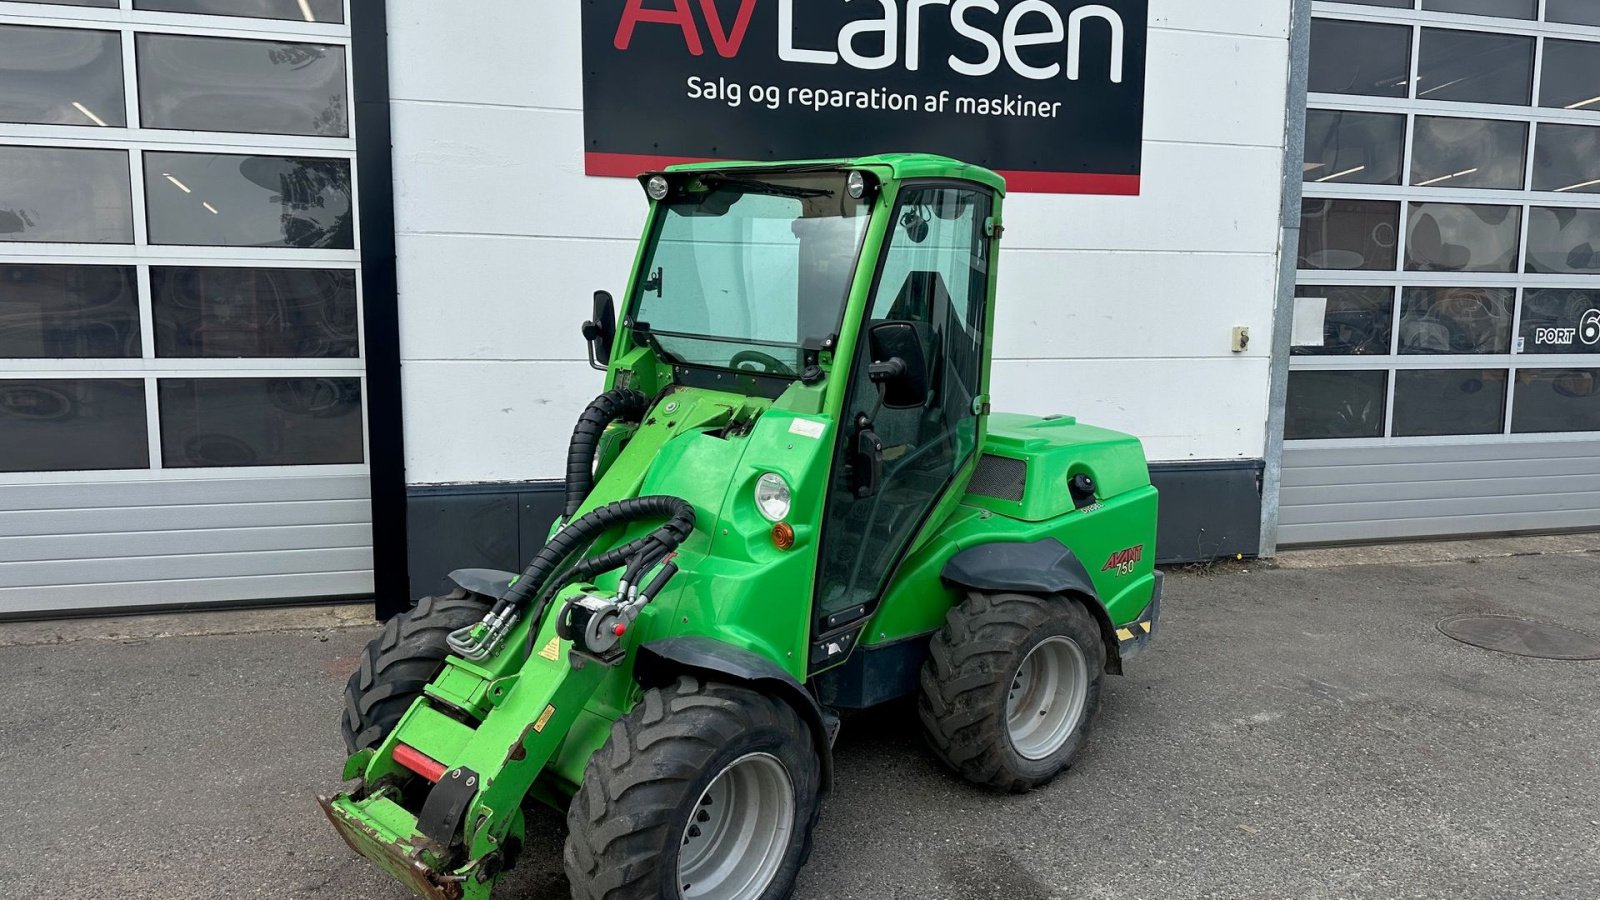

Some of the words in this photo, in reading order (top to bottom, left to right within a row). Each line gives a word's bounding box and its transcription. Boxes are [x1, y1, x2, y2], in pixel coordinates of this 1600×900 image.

[778, 0, 1124, 84] Larsen
[687, 76, 741, 108] Salg
[749, 84, 780, 110] og
[787, 87, 918, 112] reparation
[924, 90, 950, 113] af
[955, 93, 1062, 118] maskiner
[1535, 327, 1576, 345] PORT
[1579, 308, 1600, 345] 6
[1101, 544, 1143, 572] AVANT
[1115, 559, 1134, 577] 750
